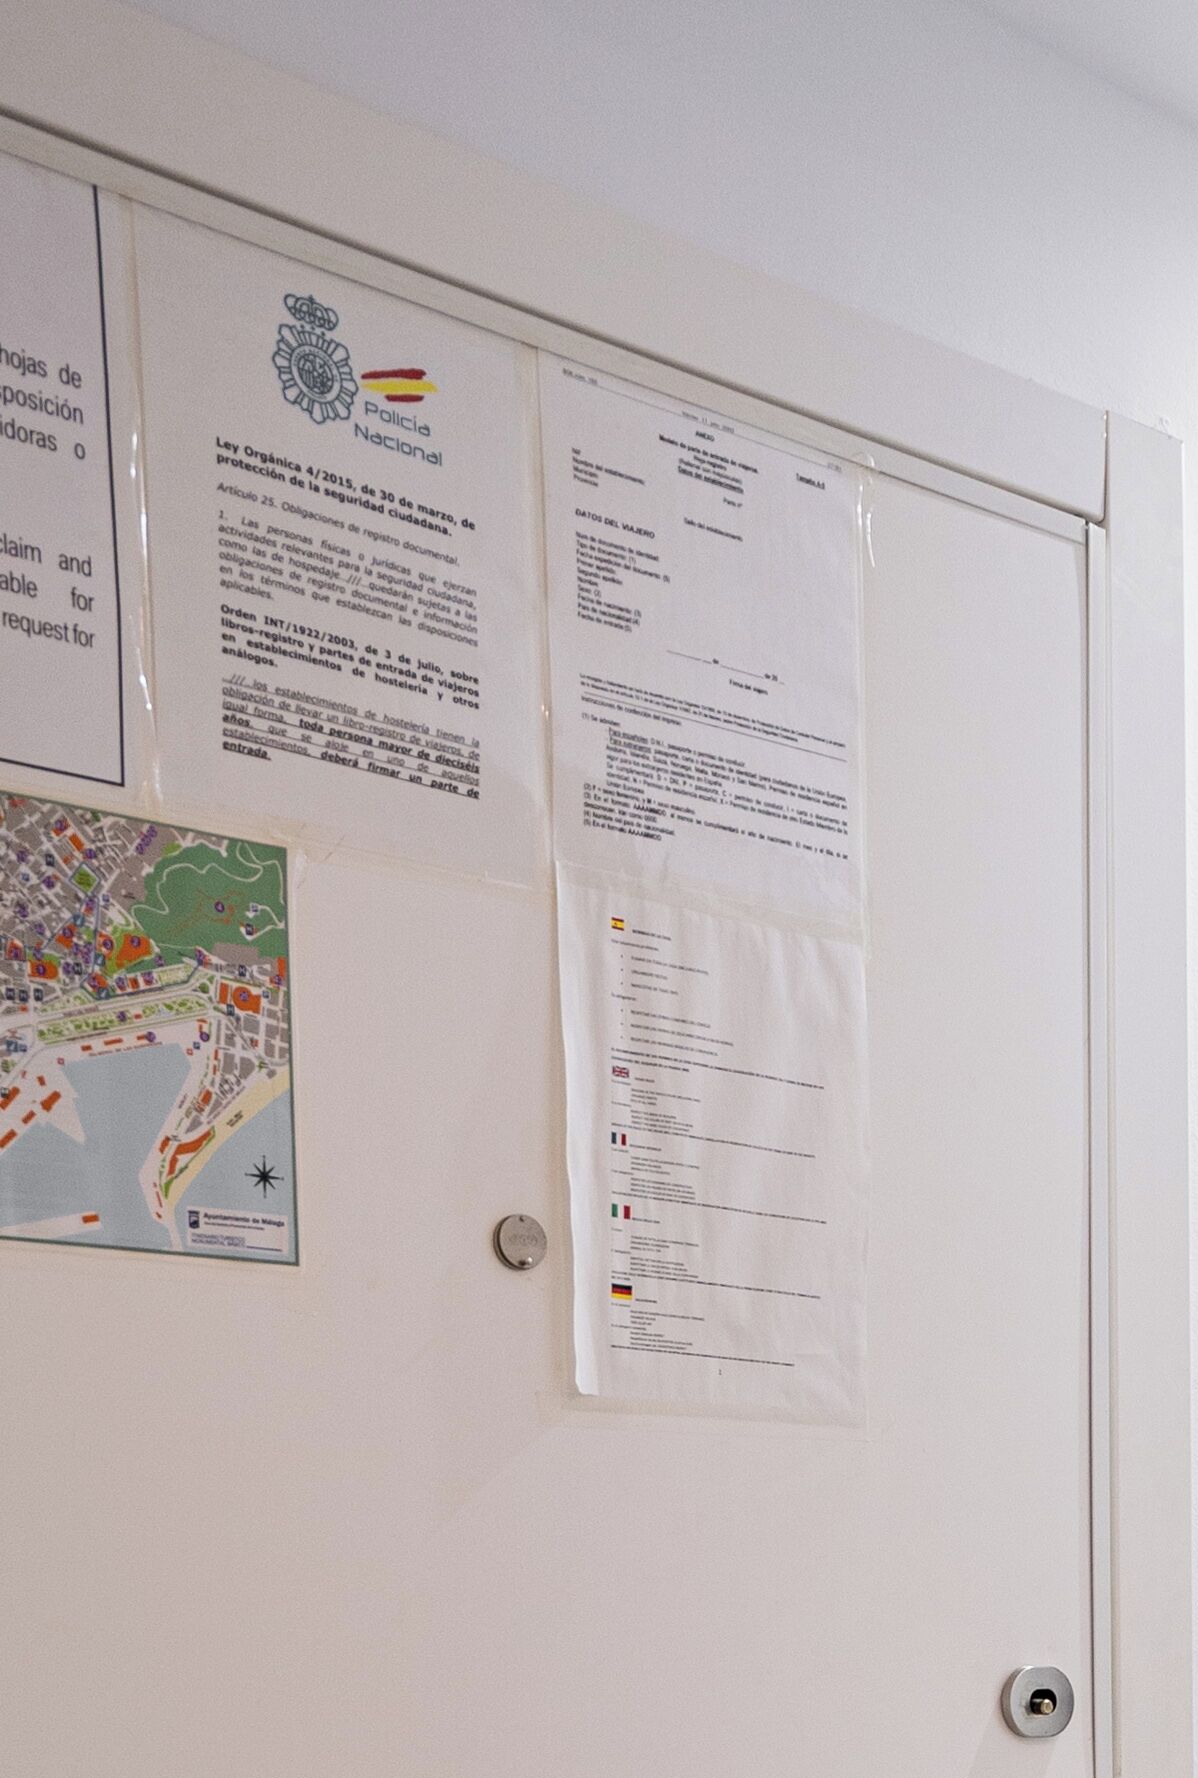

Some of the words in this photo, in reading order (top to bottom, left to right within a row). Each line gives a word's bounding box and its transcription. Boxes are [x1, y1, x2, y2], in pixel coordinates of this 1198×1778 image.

[0, 341, 47, 378] hojas
[59, 364, 82, 389] de
[0, 385, 84, 424] posición
[365, 401, 431, 437] Policía
[74, 443, 86, 460] o
[354, 423, 443, 467] Nacional
[215, 436, 240, 455] Ley
[242, 445, 302, 473] Orgánica
[305, 466, 357, 492] 4/2015,
[359, 484, 376, 497] de
[379, 489, 395, 503] 30
[397, 496, 414, 510] de
[416, 503, 457, 526] marzo,
[460, 517, 475, 531] de
[215, 452, 286, 483] protección
[287, 475, 305, 489] de
[308, 480, 320, 494] la
[322, 486, 384, 515] seguridad
[387, 507, 452, 537] ciudadana.
[215, 481, 258, 502] Artículo
[280, 500, 345, 529] Obligaciones
[346, 522, 360, 534] de
[361, 527, 400, 547] registro
[575, 507, 602, 523] DATOS
[604, 516, 619, 528] DEL
[58, 553, 92, 577] and
[217, 523, 277, 548] actividades
[280, 542, 334, 565] relevantes
[336, 559, 360, 573] para
[363, 565, 373, 577] la
[375, 570, 424, 592] seguridad
[217, 537, 248, 553] como
[251, 545, 267, 558] las
[270, 551, 284, 564] de
[288, 556, 338, 581] hospedaje
[368, 580, 413, 602] quedarán
[416, 596, 451, 614] sujetas
[453, 608, 461, 617] a
[463, 609, 477, 622] las
[240, 515, 259, 530] Las
[265, 524, 313, 546] personas
[319, 539, 351, 557] físicas
[357, 552, 365, 561] o
[369, 555, 411, 576] jurídicas
[417, 571, 436, 584] que
[441, 579, 477, 597] ejerzan
[0, 571, 37, 598] able
[71, 588, 94, 612] for
[218, 550, 284, 577] obligaciones
[288, 570, 302, 582] de
[306, 576, 346, 594] registro
[350, 589, 408, 612] documental
[411, 607, 419, 616] e
[422, 609, 478, 634] información
[218, 564, 233, 575] en
[238, 568, 254, 581] los
[259, 574, 306, 596] términos
[310, 590, 331, 603] que
[335, 597, 393, 621] establezcan
[397, 614, 412, 627] las
[416, 621, 478, 647] disposiciones
[2, 610, 69, 643] request
[72, 623, 94, 648] for
[219, 603, 257, 622] Orden
[363, 644, 379, 656] de
[383, 648, 391, 660] 3
[397, 653, 411, 665] de
[449, 669, 479, 685] sobre
[220, 616, 304, 649] libros-registro
[307, 642, 315, 653] y
[318, 644, 355, 663] partes
[357, 655, 372, 667] de
[374, 661, 417, 680] entrada
[420, 672, 434, 685] de
[436, 678, 479, 698] viajeros
[220, 631, 235, 644] en
[245, 638, 342, 672] establecimientos
[350, 666, 366, 678] de
[373, 671, 428, 695] hostelería
[436, 690, 444, 701] y
[451, 695, 480, 710] otros
